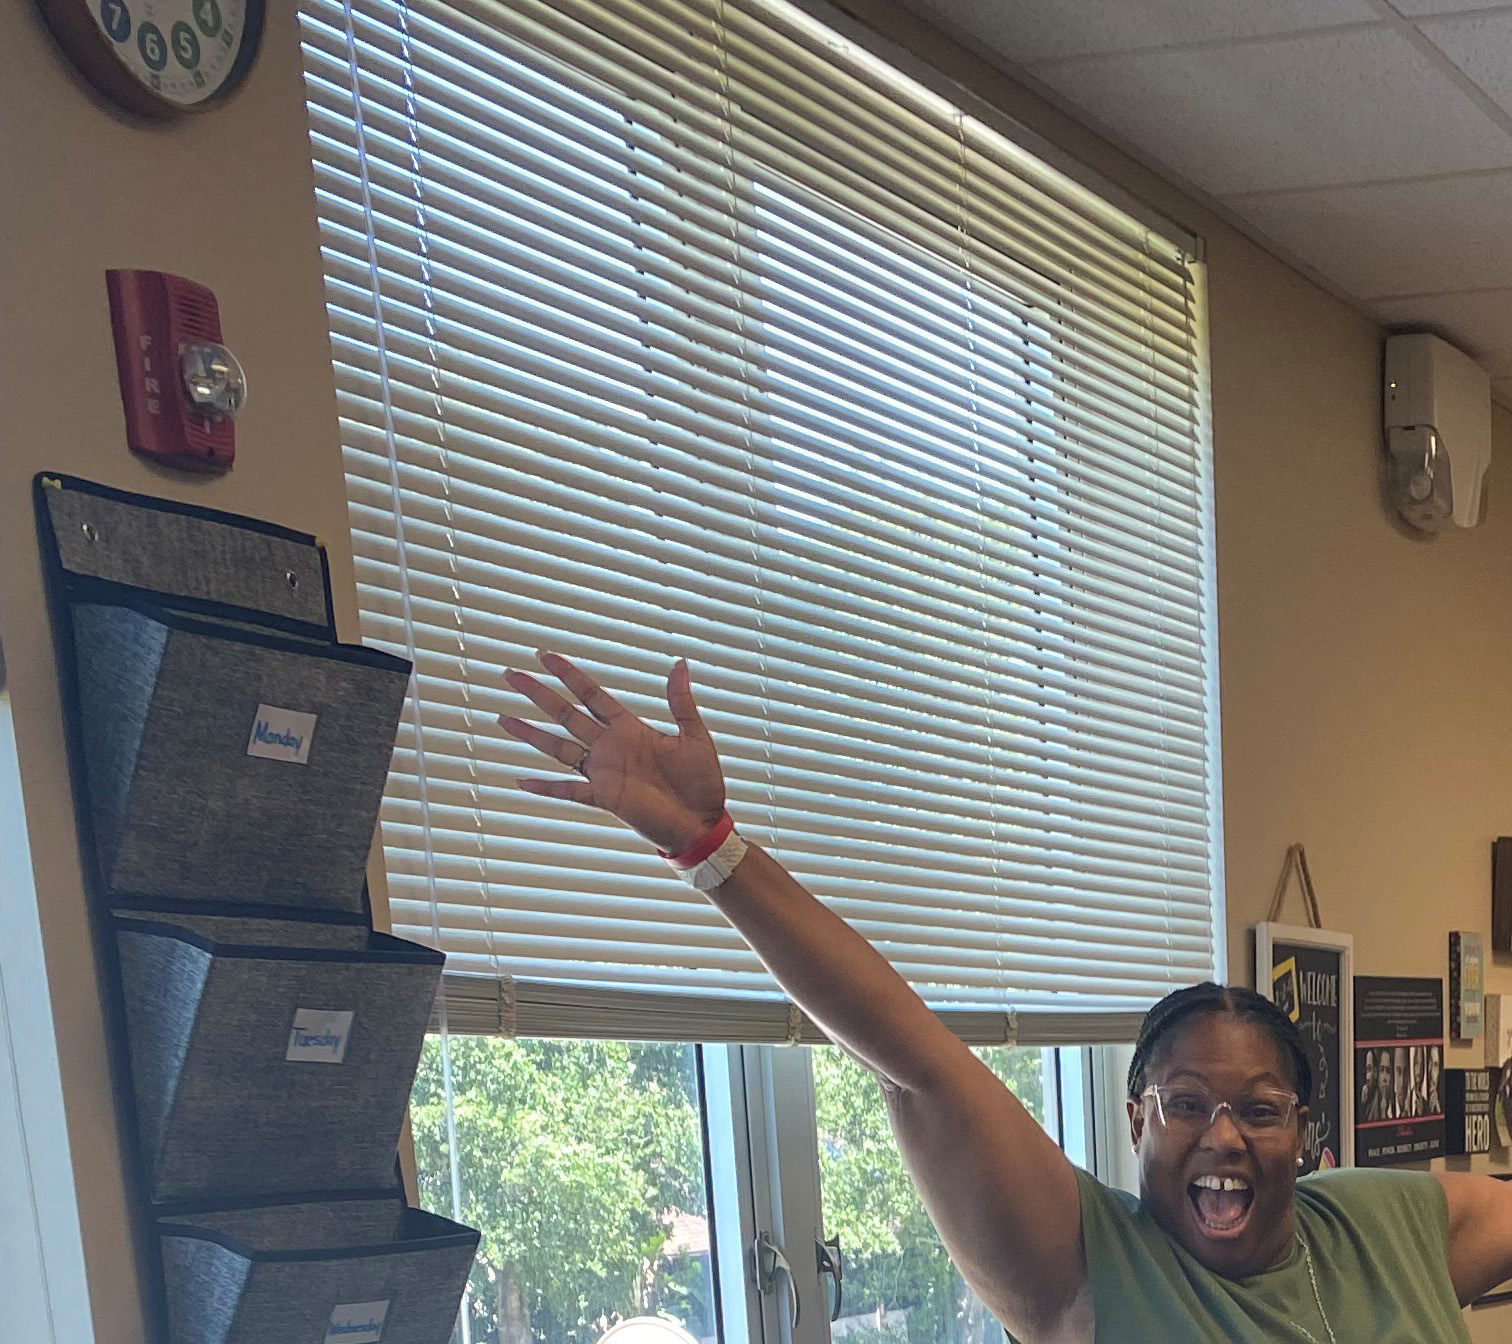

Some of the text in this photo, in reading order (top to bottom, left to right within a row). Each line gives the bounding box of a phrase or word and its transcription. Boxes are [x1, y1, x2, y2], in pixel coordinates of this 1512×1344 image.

[108, 4, 121, 30] 7
[199, 0, 214, 24] 4
[145, 33, 160, 61] 6
[179, 31, 193, 60] 5
[139, 335, 161, 415] FIRE
[253, 719, 304, 757] Monday
[1299, 969, 1338, 1008] WELCOME
[292, 1029, 342, 1054] Tuesday
[1465, 1113, 1490, 1153] HERO
